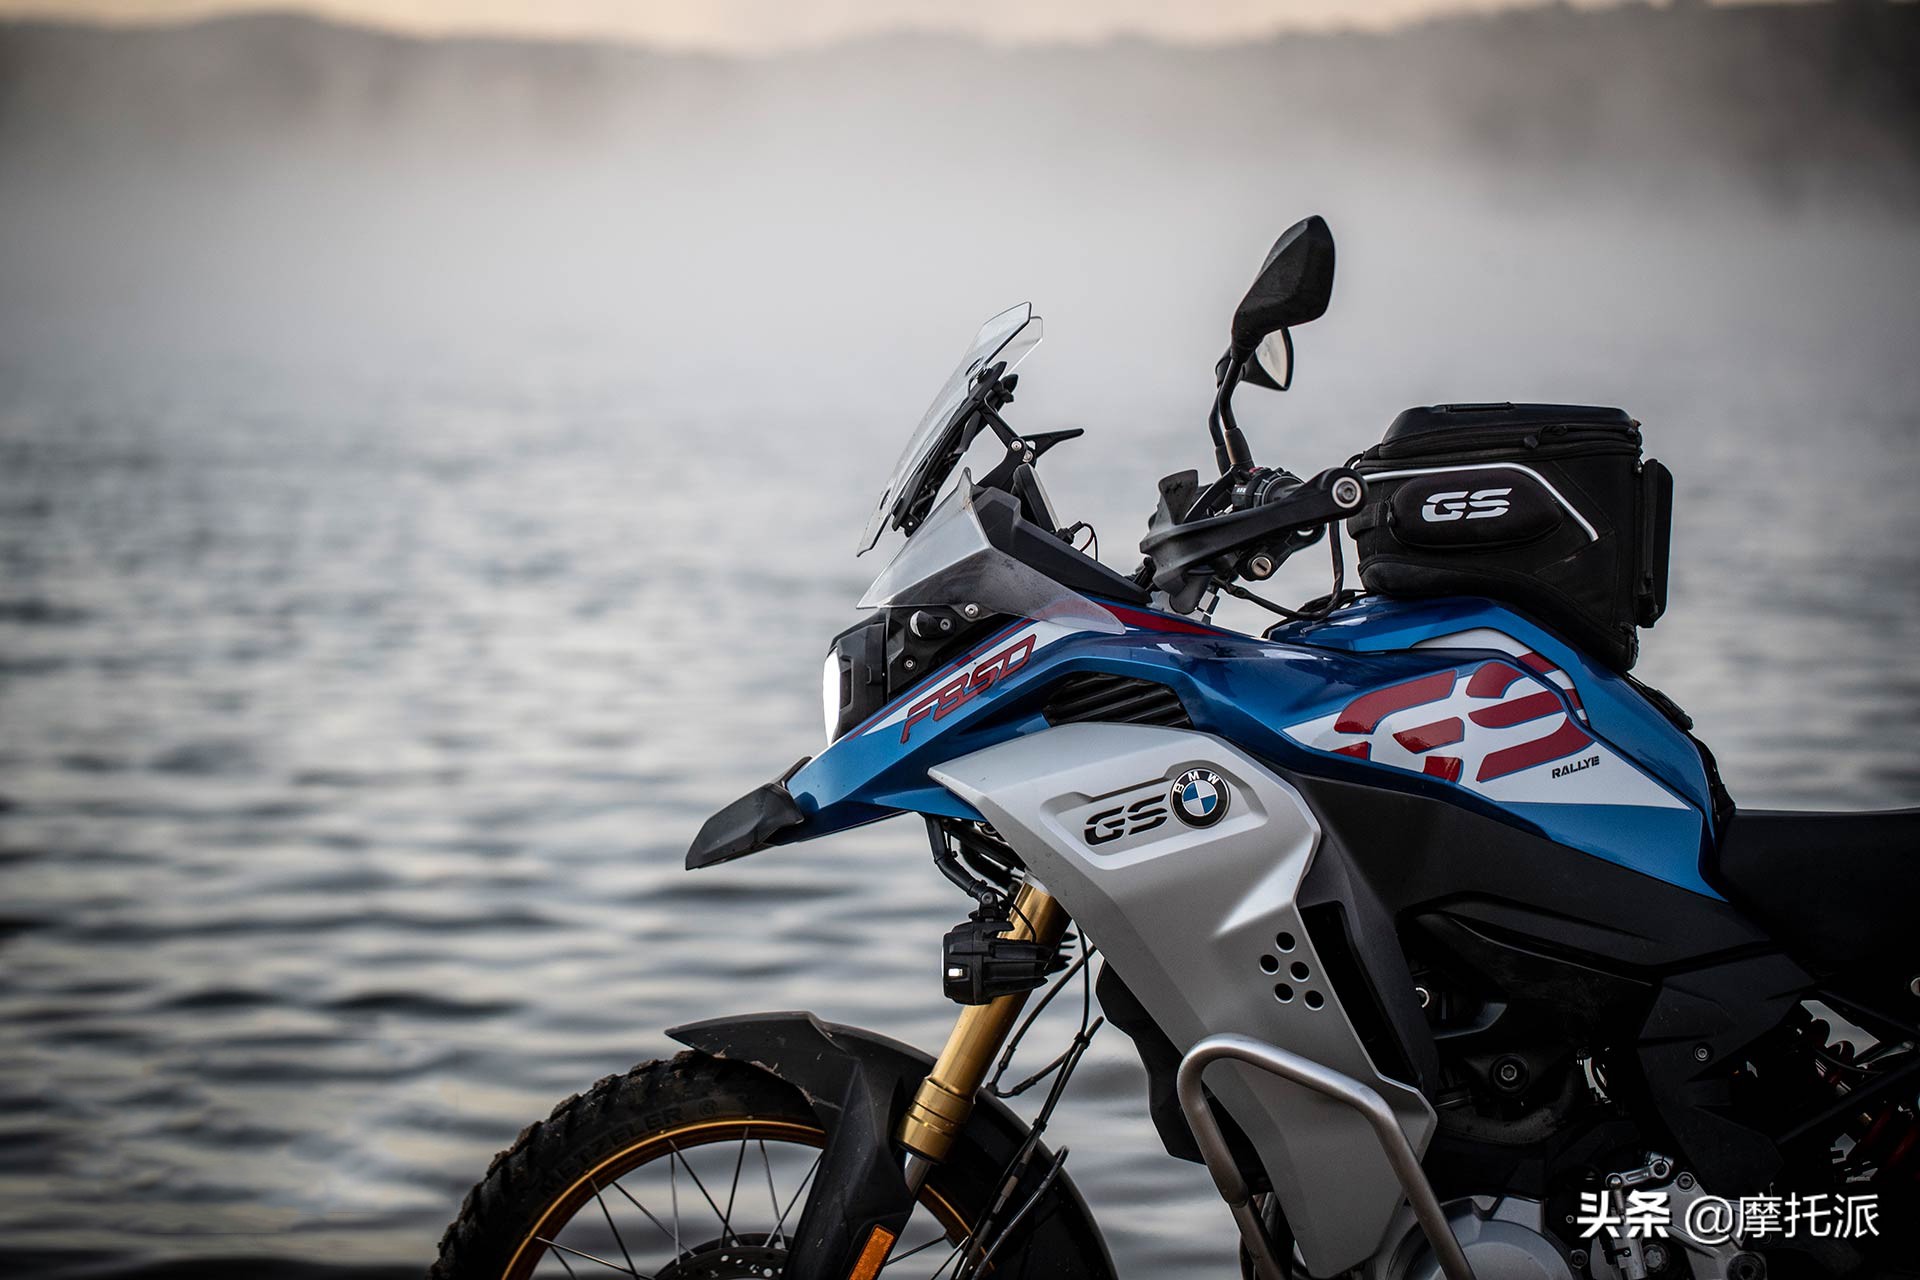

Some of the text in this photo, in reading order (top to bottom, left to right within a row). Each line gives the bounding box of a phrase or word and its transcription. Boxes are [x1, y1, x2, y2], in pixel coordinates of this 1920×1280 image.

[1422, 488, 1513, 522] GS
[900, 633, 1037, 745] F850
[1330, 655, 1590, 784] GS
[1173, 770, 1220, 795] BMW
[1551, 755, 1600, 779] RALLYE
[1084, 793, 1168, 846] GS
[540, 1104, 685, 1198] METZELER
